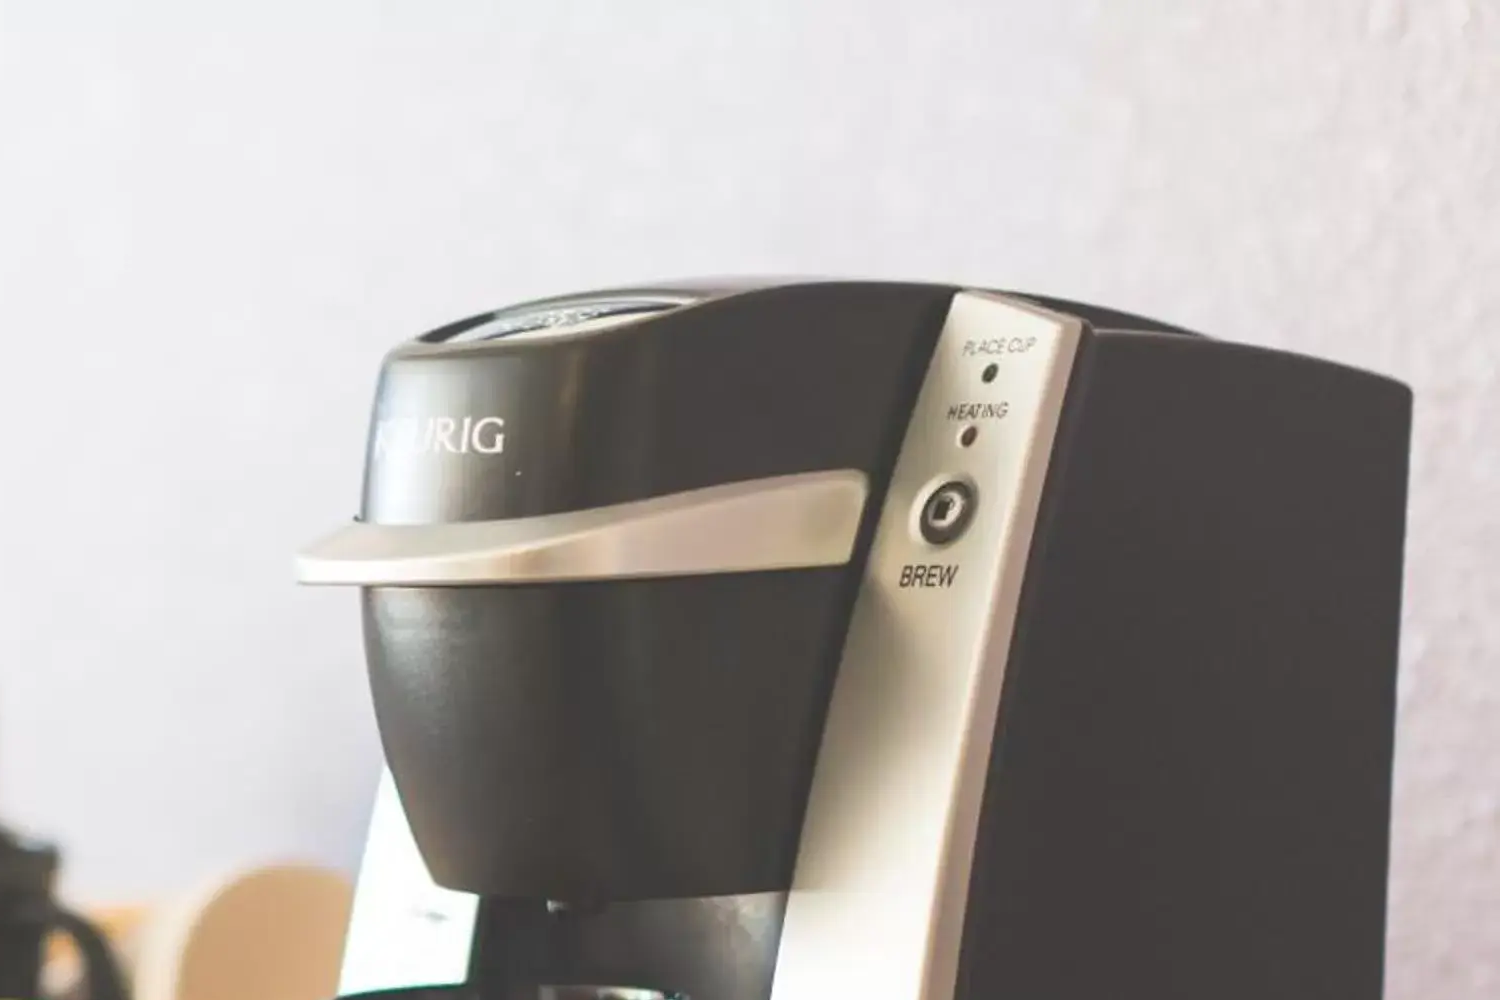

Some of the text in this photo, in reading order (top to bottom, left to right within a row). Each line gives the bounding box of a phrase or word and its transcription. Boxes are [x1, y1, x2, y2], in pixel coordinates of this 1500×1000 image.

[1007, 336, 1038, 354] CUP
[946, 401, 1009, 421] HEATING
[898, 564, 960, 589] BREW
